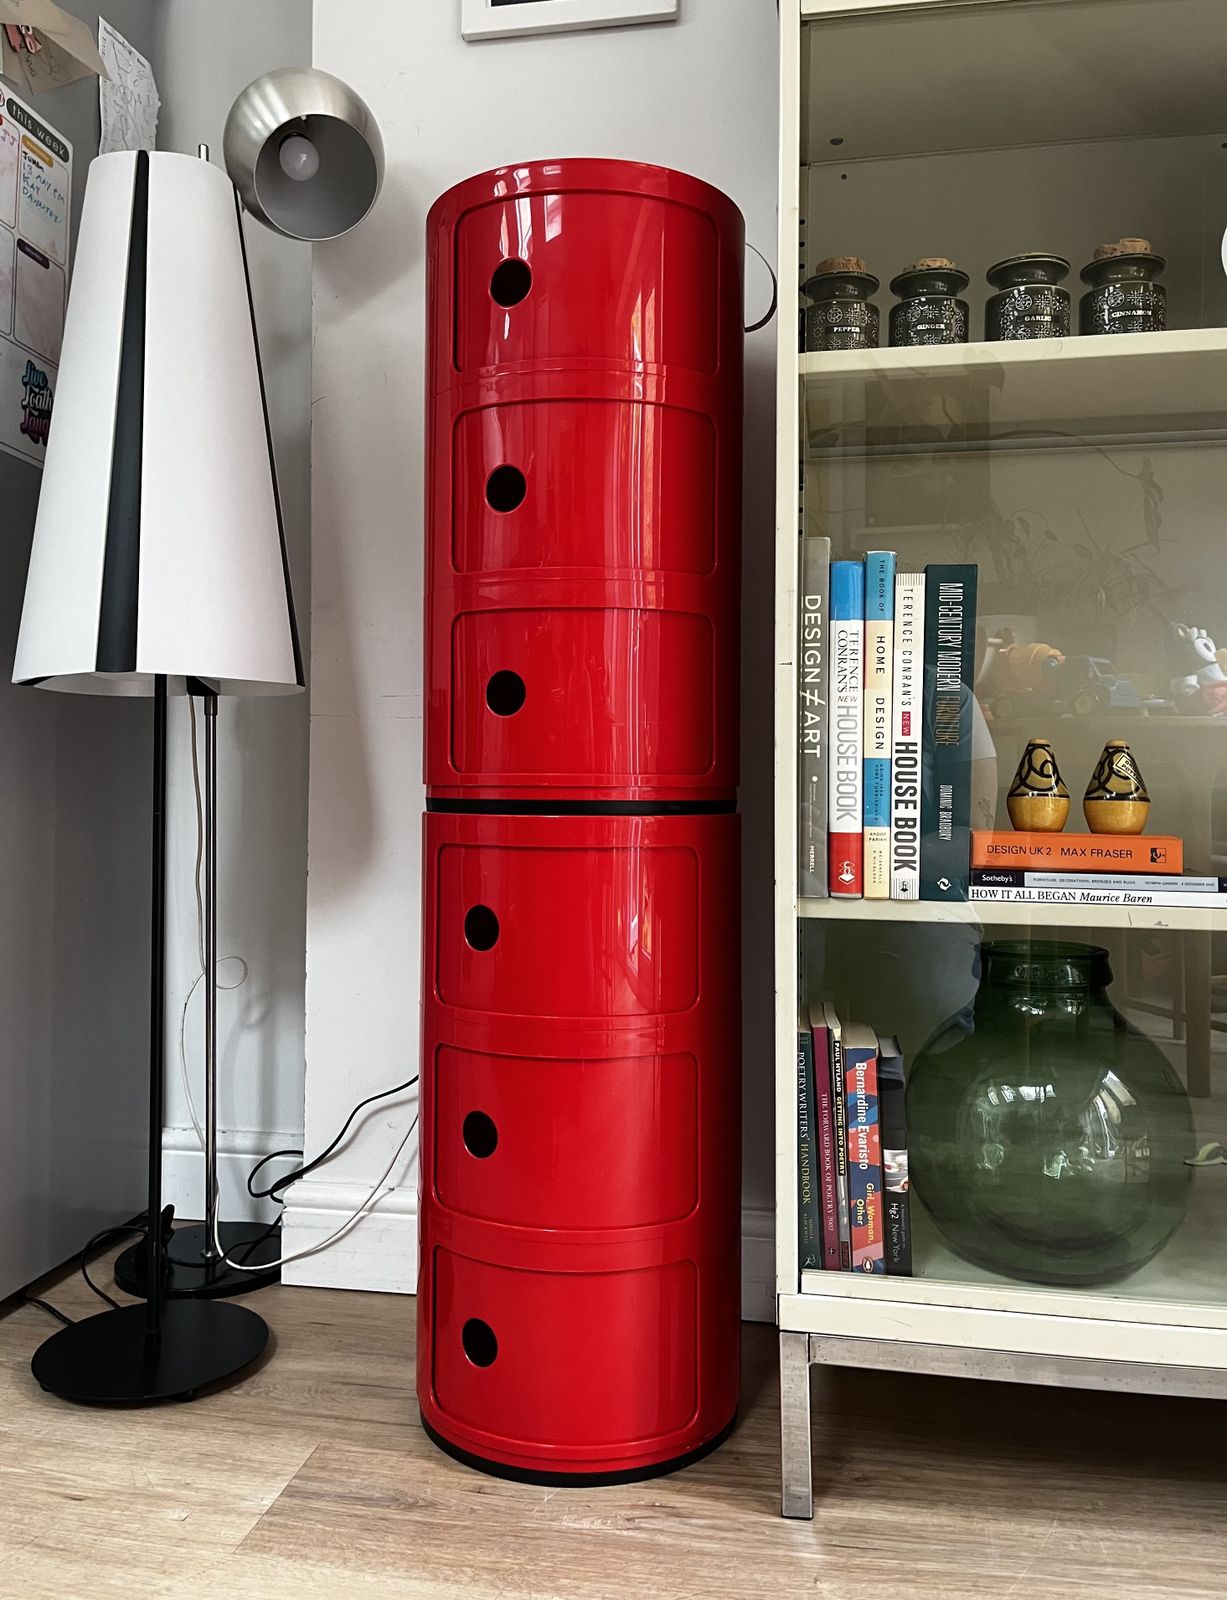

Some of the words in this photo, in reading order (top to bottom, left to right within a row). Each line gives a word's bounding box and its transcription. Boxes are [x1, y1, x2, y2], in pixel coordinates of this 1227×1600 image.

[12, 104, 32, 130] this
[36, 126, 65, 158] week
[1111, 309, 1152, 318] CINNAMON
[878, 602, 885, 613] OF
[902, 588, 914, 644] TERENCE
[937, 582, 964, 648] MID-CENTURY
[804, 594, 822, 683] DESIGN
[875, 635, 886, 674] HOME
[837, 629, 848, 693] CONRAN'S
[849, 630, 859, 693] TERENCE
[901, 650, 915, 706] CONRAN'S
[936, 651, 962, 692] MODERN
[838, 695, 858, 703] NEW
[804, 711, 821, 759] ART
[836, 705, 858, 766] HOUSE
[875, 697, 885, 750] DESIGN
[902, 712, 911, 736] NEW
[935, 695, 961, 747] FURNITURE
[894, 741, 918, 810] HOUSE
[836, 770, 858, 821] BOOK
[939, 784, 953, 809] DOMINIC
[893, 817, 917, 872] BOOK
[938, 811, 953, 841] BRADBURY
[986, 844, 1027, 855] DESIGN
[1029, 846, 1044, 856] UK
[1046, 847, 1052, 856] 2
[1060, 847, 1087, 857] MAX
[1090, 848, 1133, 859] FRASER
[971, 889, 998, 899] HOW
[1001, 890, 1012, 899] IT
[1014, 890, 1035, 900] ALL
[1037, 891, 1076, 901] BEGAN
[1079, 892, 1120, 903] Maurice
[1122, 893, 1153, 903] Baren
[981, 874, 1013, 884] Sotheby's
[798, 1052, 806, 1091] POETRY
[855, 1062, 869, 1123] Bernardine
[799, 1091, 810, 1141] WRITERS'
[822, 1110, 831, 1148] FORWARD
[824, 1149, 832, 1171] BOOK
[838, 1146, 846, 1175] POETRY
[858, 1125, 870, 1170] Evaristo
[800, 1143, 811, 1206] HANDBOOK
[825, 1172, 832, 1182] OF
[866, 1182, 875, 1203] Girl,
[825, 1183, 834, 1216] POETRY
[856, 1198, 866, 1225] Other
[889, 1202, 899, 1219] Hg2
[867, 1205, 876, 1243] Woman,
[891, 1223, 899, 1243] New
[892, 1244, 900, 1263] York
